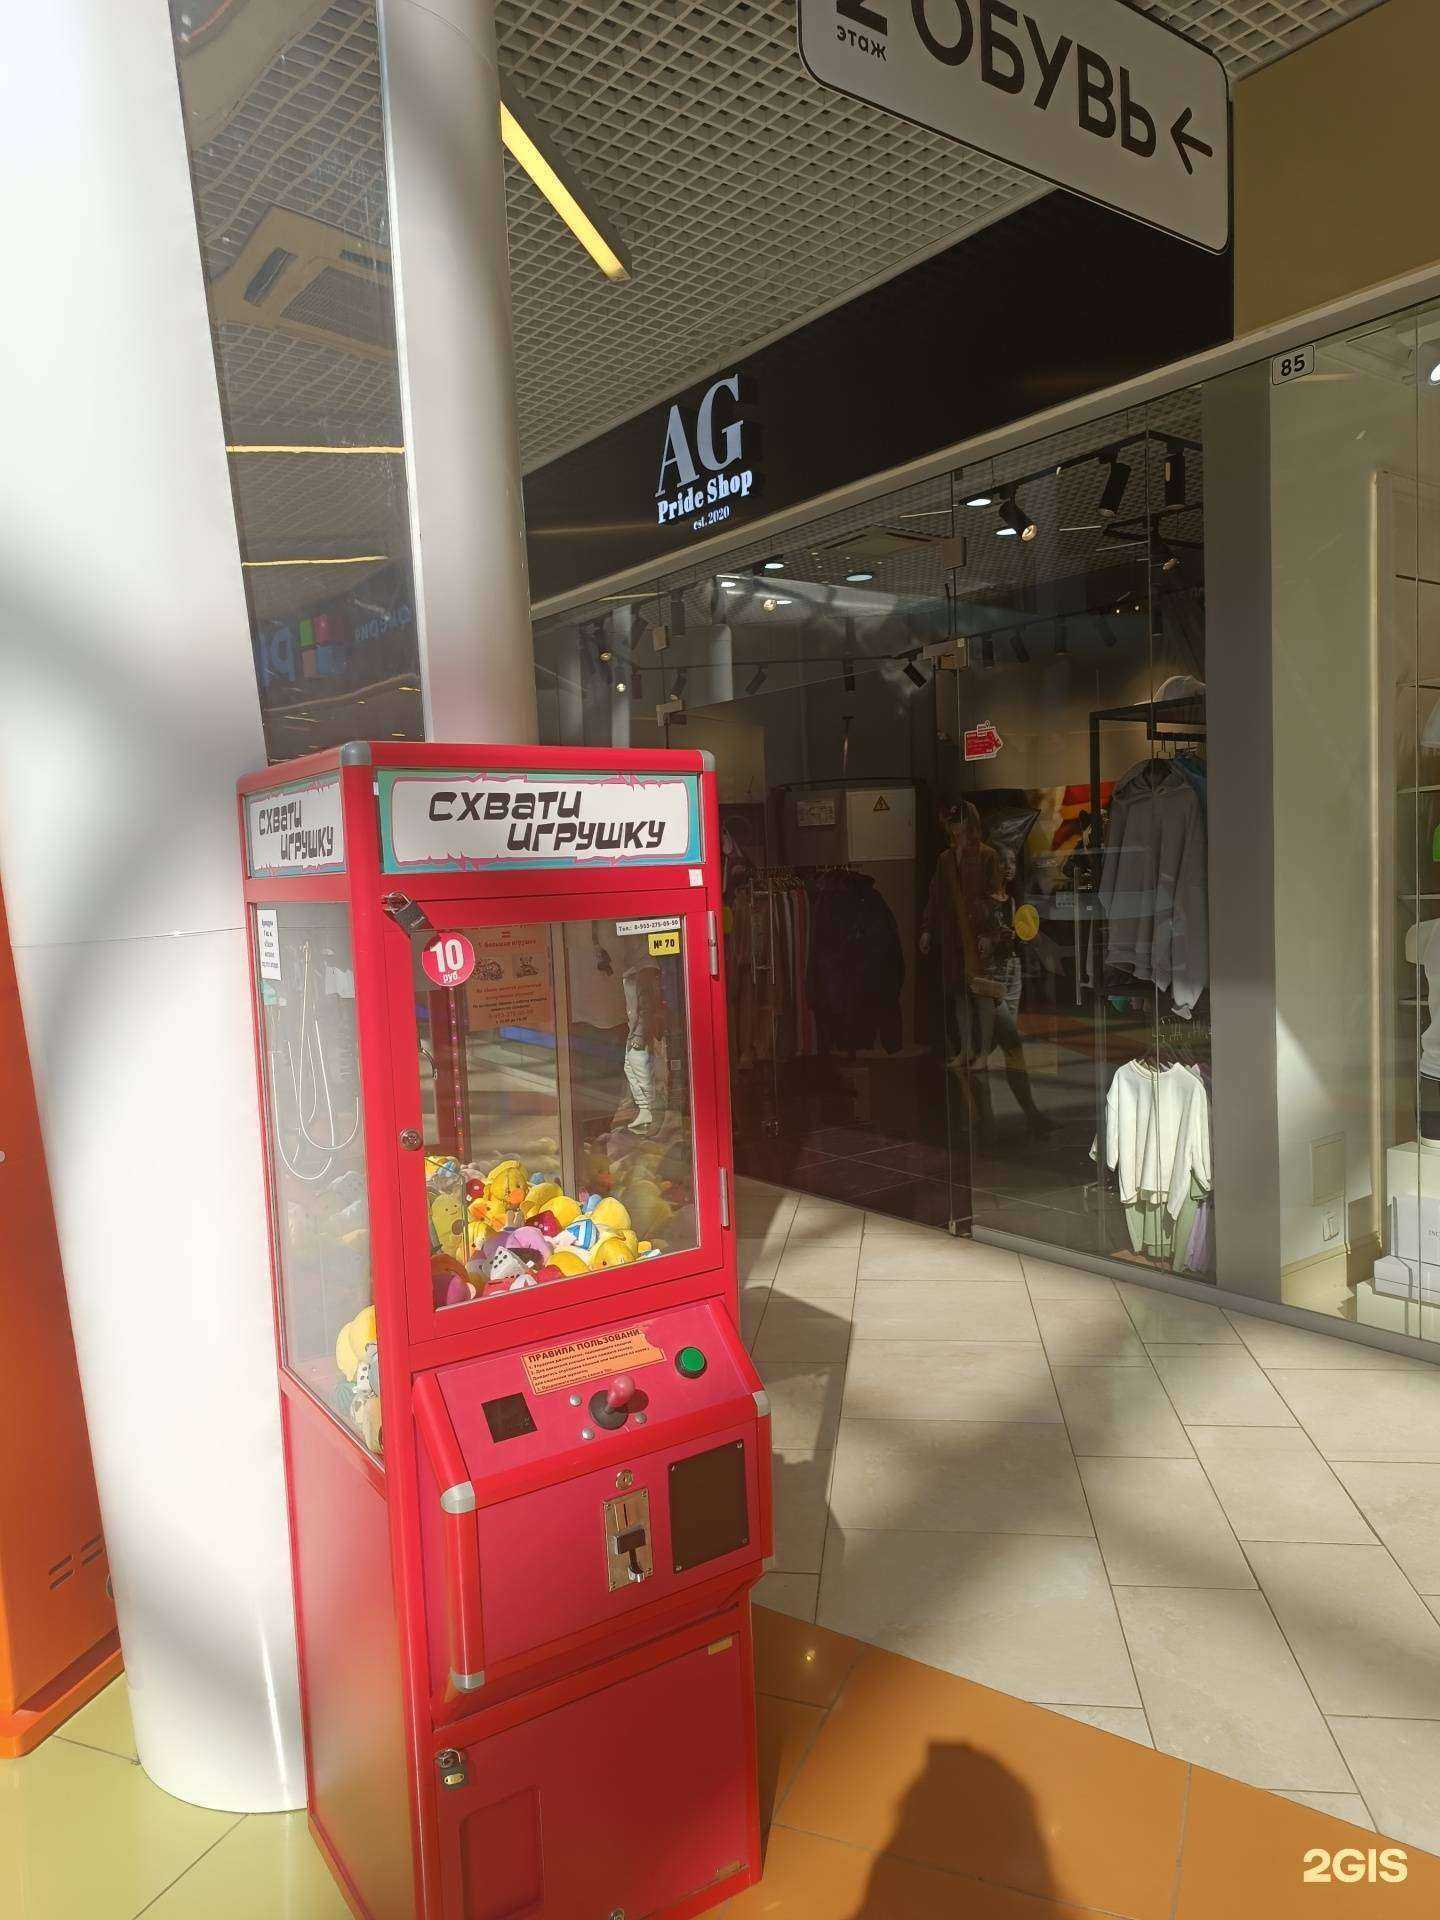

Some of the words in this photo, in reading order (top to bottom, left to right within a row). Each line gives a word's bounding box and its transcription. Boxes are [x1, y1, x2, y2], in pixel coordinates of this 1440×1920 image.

[837, 25, 887, 62] этаж
[911, 0, 1157, 158] ОБУВЬ
[1281, 354, 1305, 377] 85
[655, 374, 744, 498] AG
[657, 486, 704, 524] Pride
[707, 470, 753, 503] Shop
[693, 517, 707, 530] est.
[708, 505, 730, 525] 2020
[430, 939, 464, 973] 10
[665, 939, 675, 948] 70
[528, 1345, 575, 1363] ПРАВИЛА
[576, 1328, 641, 1350] ПОЛЬЗОВАНИ
